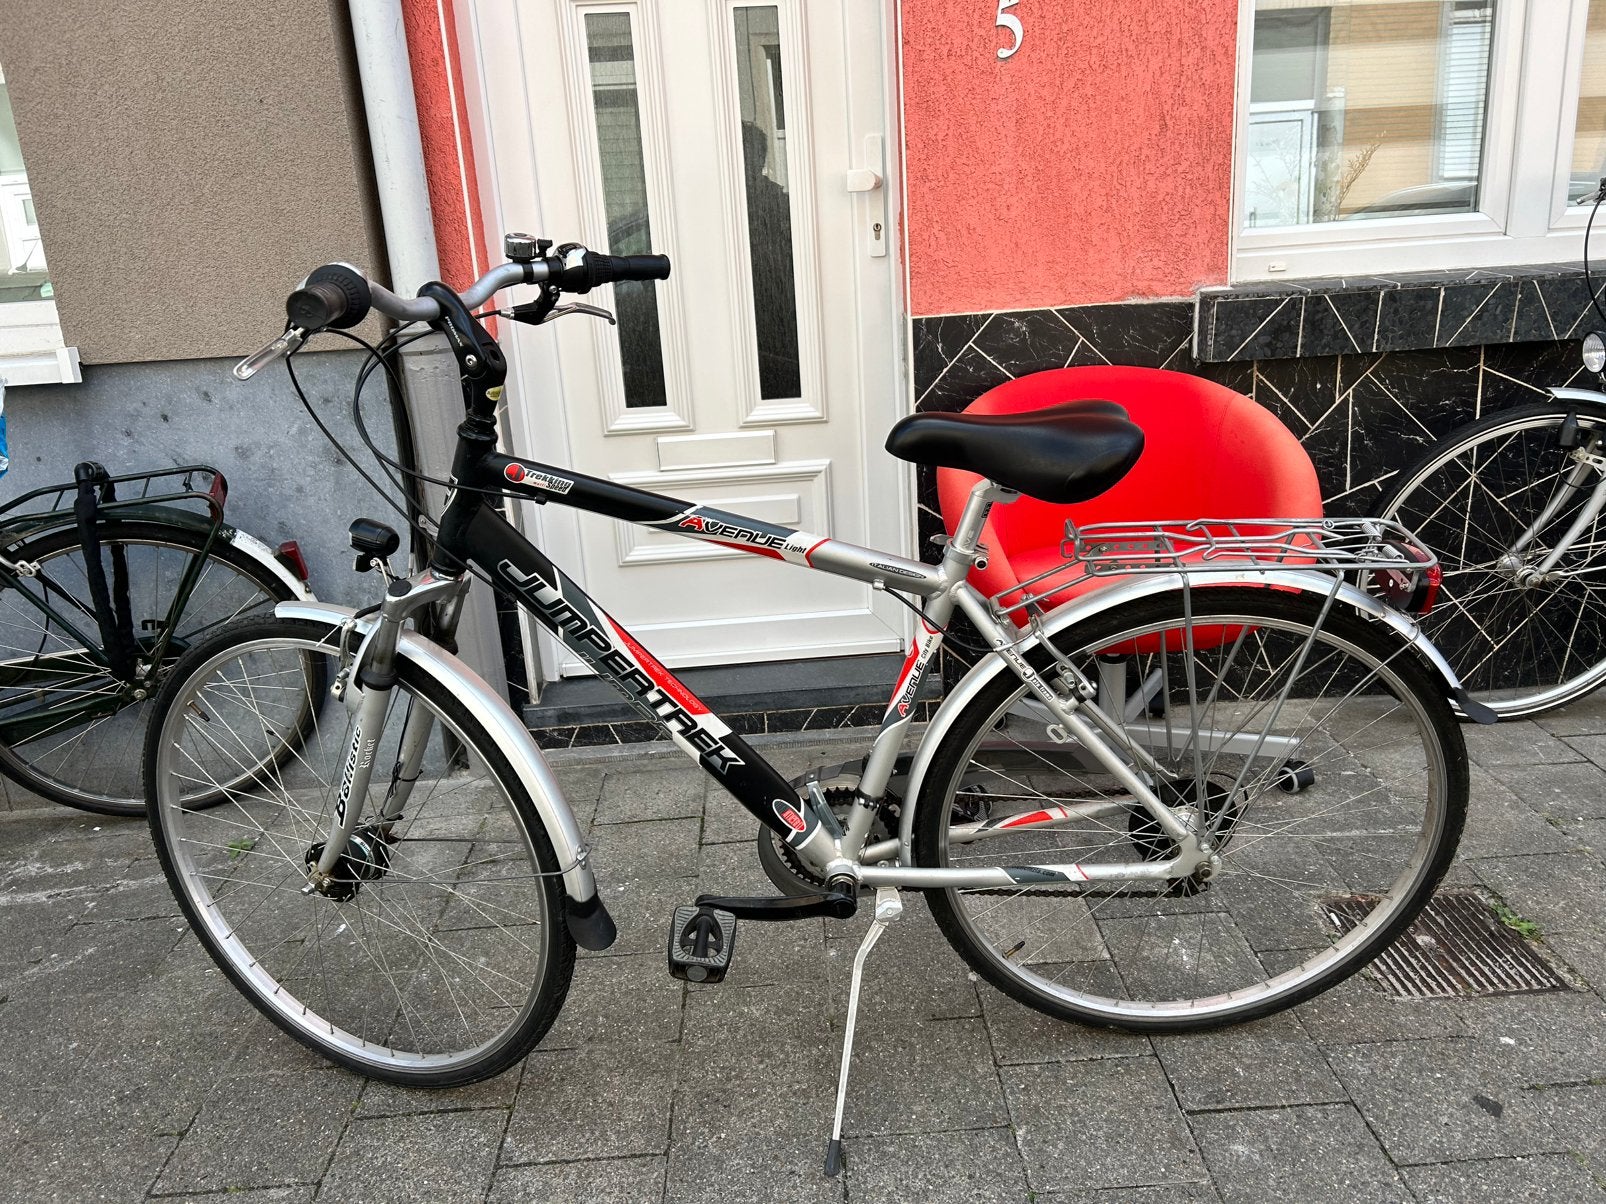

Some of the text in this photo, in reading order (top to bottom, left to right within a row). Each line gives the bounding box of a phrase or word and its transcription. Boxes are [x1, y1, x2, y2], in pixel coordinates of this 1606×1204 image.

[995, 0, 1024, 59] 5
[525, 469, 572, 490] Trekking
[679, 515, 807, 554] AVENUE Light
[871, 562, 899, 573] ITALIAN
[497, 558, 746, 776] JUMPERTREK
[996, 639, 1027, 669] AENUE
[664, 676, 703, 711] TECHNOLOGY
[898, 635, 934, 717] AVENUE City Bike
